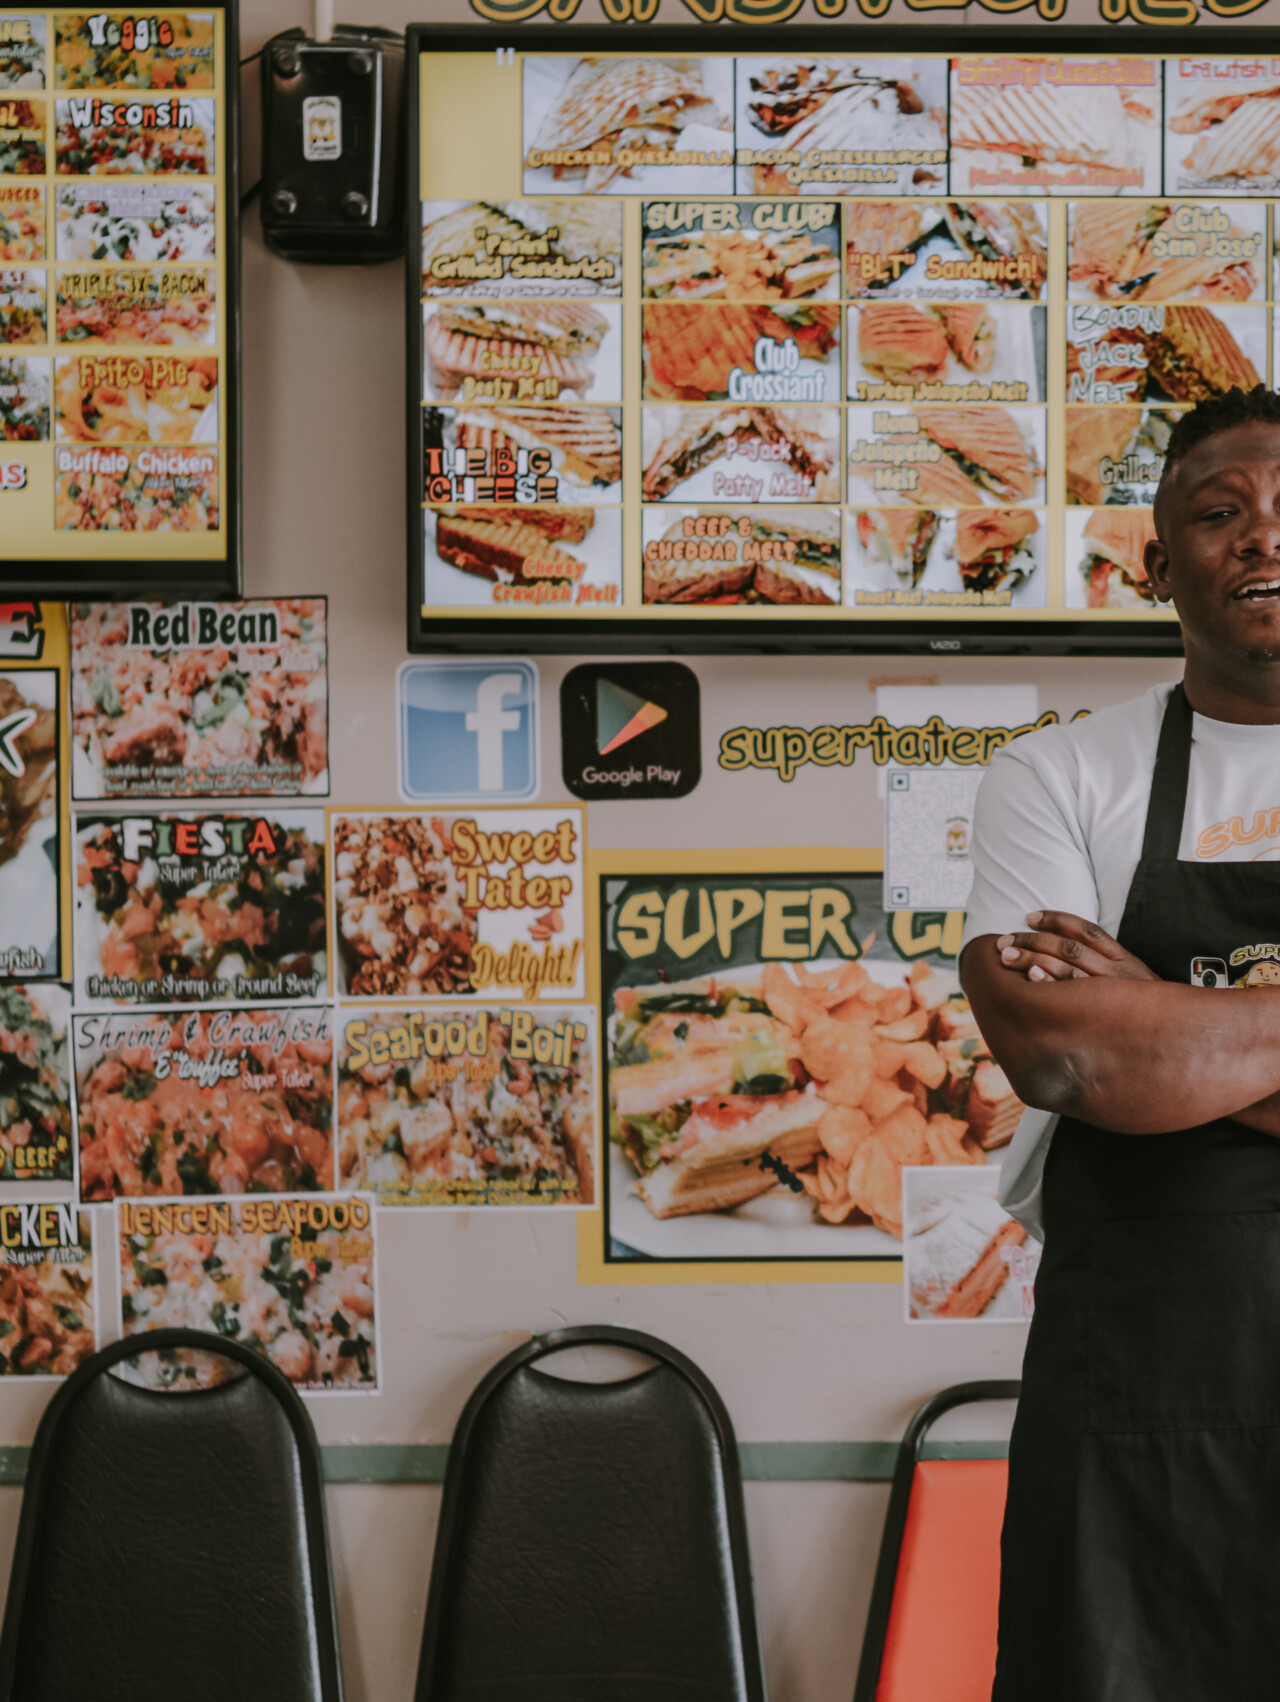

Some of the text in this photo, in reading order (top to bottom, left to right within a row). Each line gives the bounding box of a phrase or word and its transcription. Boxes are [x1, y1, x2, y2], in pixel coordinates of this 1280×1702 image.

[88, 14, 174, 52] Veggie
[69, 98, 193, 128] Wisconsin
[646, 203, 836, 231] SUPER CLUB!
[1175, 205, 1231, 233] Club
[1152, 231, 1198, 257] San
[431, 255, 615, 279] Grilled Sandwich
[850, 253, 1038, 280] "BLT" Sandwich!
[62, 272, 208, 297] TRIPLE BACON
[754, 337, 800, 372] Club
[1074, 336, 1149, 370] JACK
[80, 357, 144, 388] Frito
[151, 357, 188, 387] Pie
[728, 367, 826, 401] Crossiant
[1069, 372, 1138, 404] MELT
[873, 411, 920, 434] Ham
[58, 452, 214, 474] Buffalo Chicken
[426, 447, 551, 476] THE BIG
[1098, 454, 1162, 484] Grilled
[429, 476, 558, 503] CHEESE
[713, 472, 812, 502] Patty Melt
[874, 467, 919, 490] Melt
[682, 516, 733, 537] BEEF
[646, 540, 798, 562] CHEDDAR MELT
[130, 602, 281, 648] Red Bean
[582, 765, 681, 786] Google Play
[121, 817, 277, 865] FIESTA
[451, 819, 577, 866] Sweet
[456, 865, 573, 910] Tater
[613, 885, 862, 960] SUPER
[471, 938, 583, 1002] Delight!
[80, 1008, 330, 1055] Shrimp Crawfish
[500, 1009, 588, 1069] "Boil"
[121, 1197, 371, 1236] LENTEN SEAFOOD
